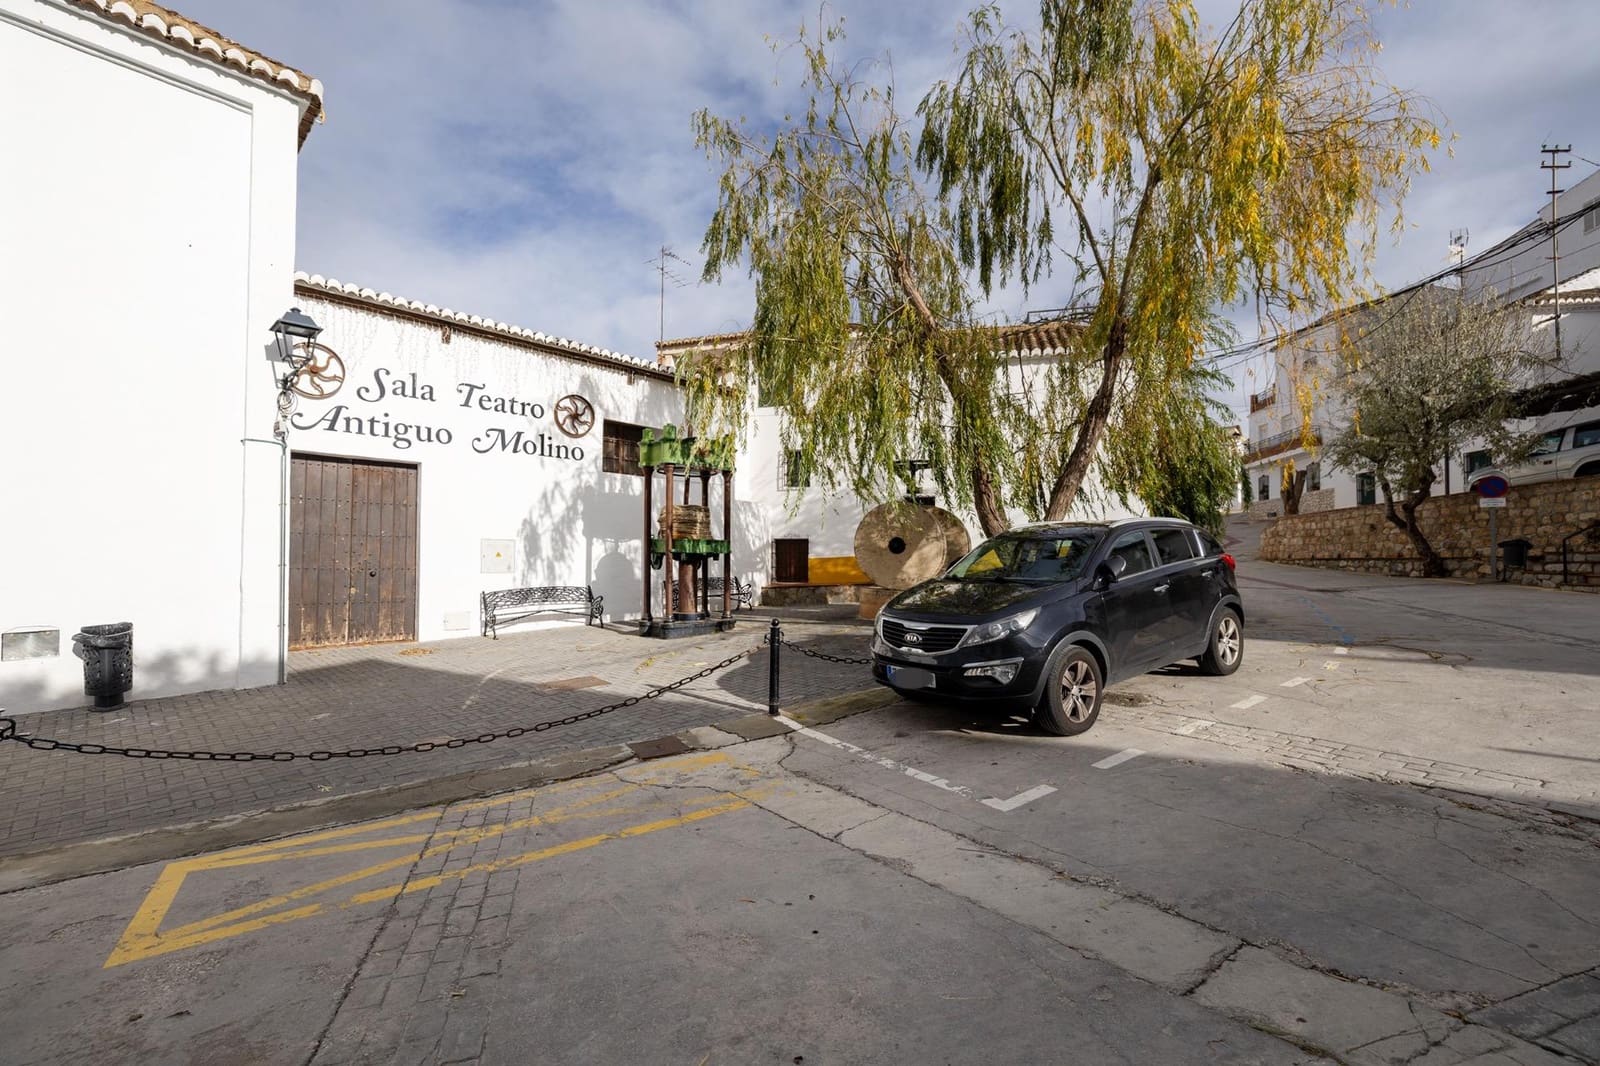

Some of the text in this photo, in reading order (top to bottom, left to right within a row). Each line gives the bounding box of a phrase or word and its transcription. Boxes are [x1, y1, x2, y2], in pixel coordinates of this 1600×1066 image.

[357, 368, 545, 419] Sala Teatro
[290, 405, 584, 461] Antiguo Molino
